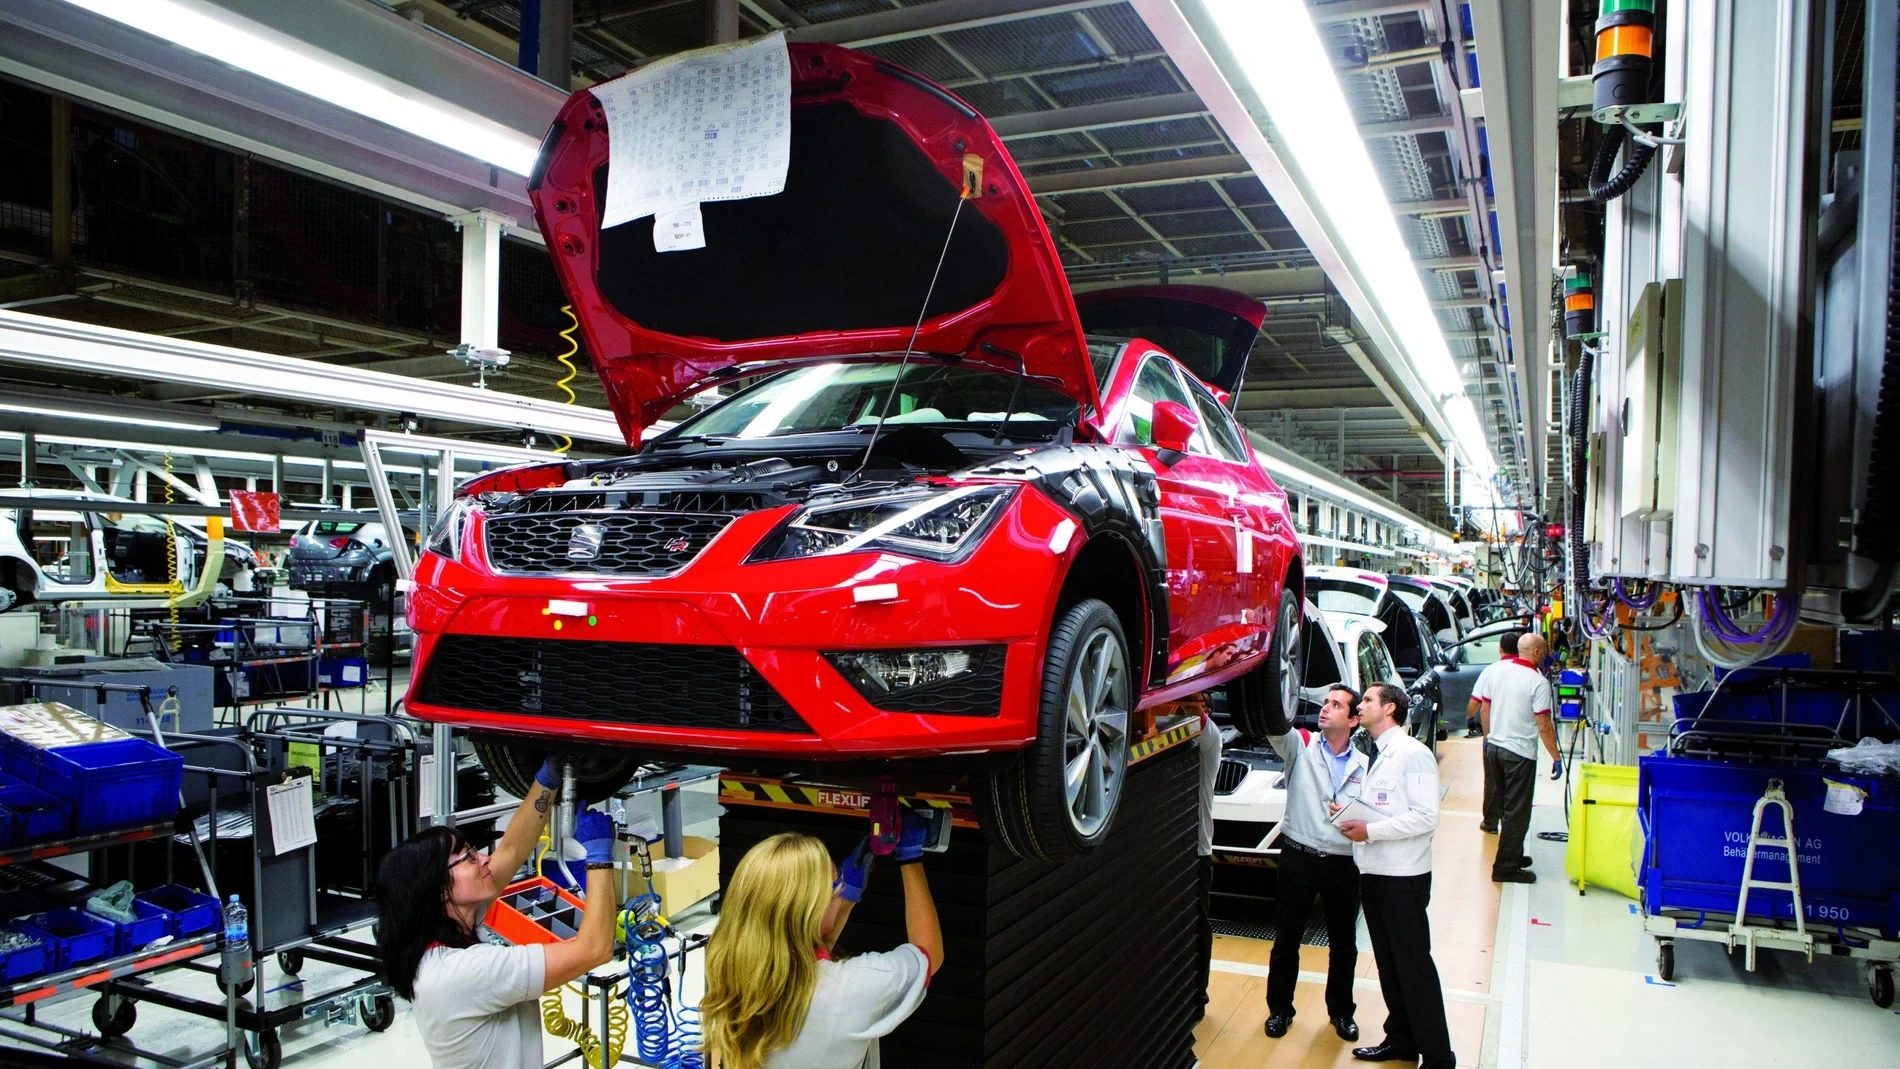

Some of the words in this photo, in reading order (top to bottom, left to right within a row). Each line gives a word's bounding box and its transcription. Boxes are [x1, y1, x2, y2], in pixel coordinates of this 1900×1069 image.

[324, 435, 338, 444] 118
[818, 791, 872, 808] FLEXLIF
[1804, 838, 1822, 850] AG
[1818, 906, 1850, 920] 950
